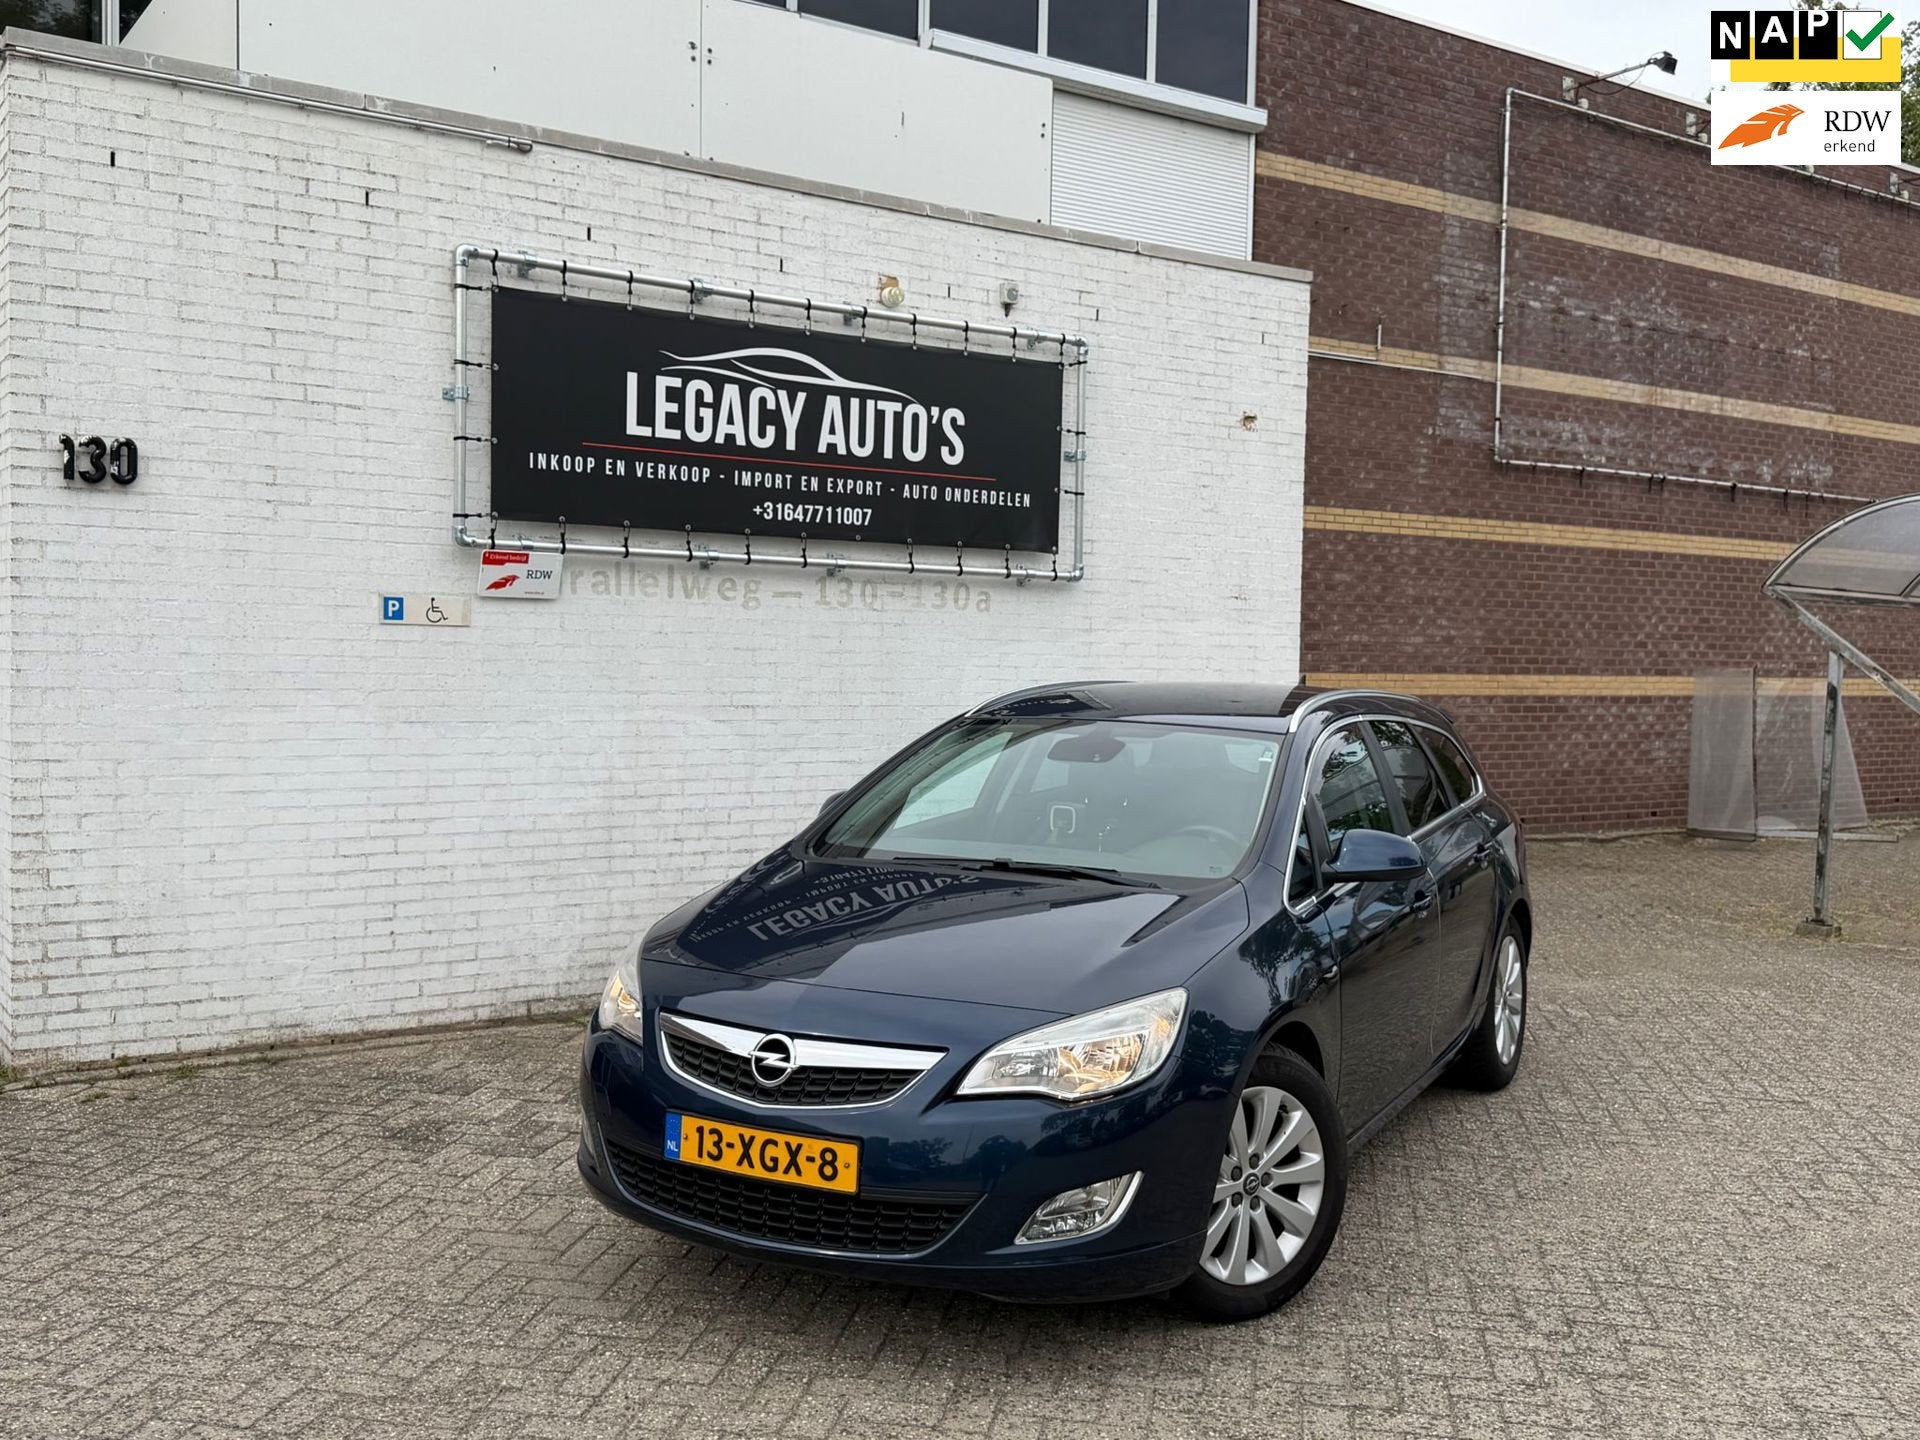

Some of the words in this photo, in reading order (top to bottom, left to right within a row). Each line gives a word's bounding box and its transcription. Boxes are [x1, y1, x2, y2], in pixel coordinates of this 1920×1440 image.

[626, 371, 807, 451] LEGACY
[817, 395, 966, 466] AUTO'S
[59, 433, 138, 485] 130
[529, 452, 596, 473] INKOOP
[605, 459, 625, 476] EN
[635, 461, 711, 483] VERKOOP
[734, 469, 792, 490] IMPORT
[801, 476, 819, 492] EN
[827, 477, 883, 497] EXPORT
[903, 484, 938, 501] AUTO
[945, 487, 1031, 508] ONDERDELEN
[752, 501, 873, 526] +31647711007
[526, 569, 553, 580] RDW
[568, 561, 762, 610] rallelweg
[388, 599, 400, 617] P
[666, 1139, 679, 1152] NL
[695, 1125, 839, 1182] 13-XGX-8
